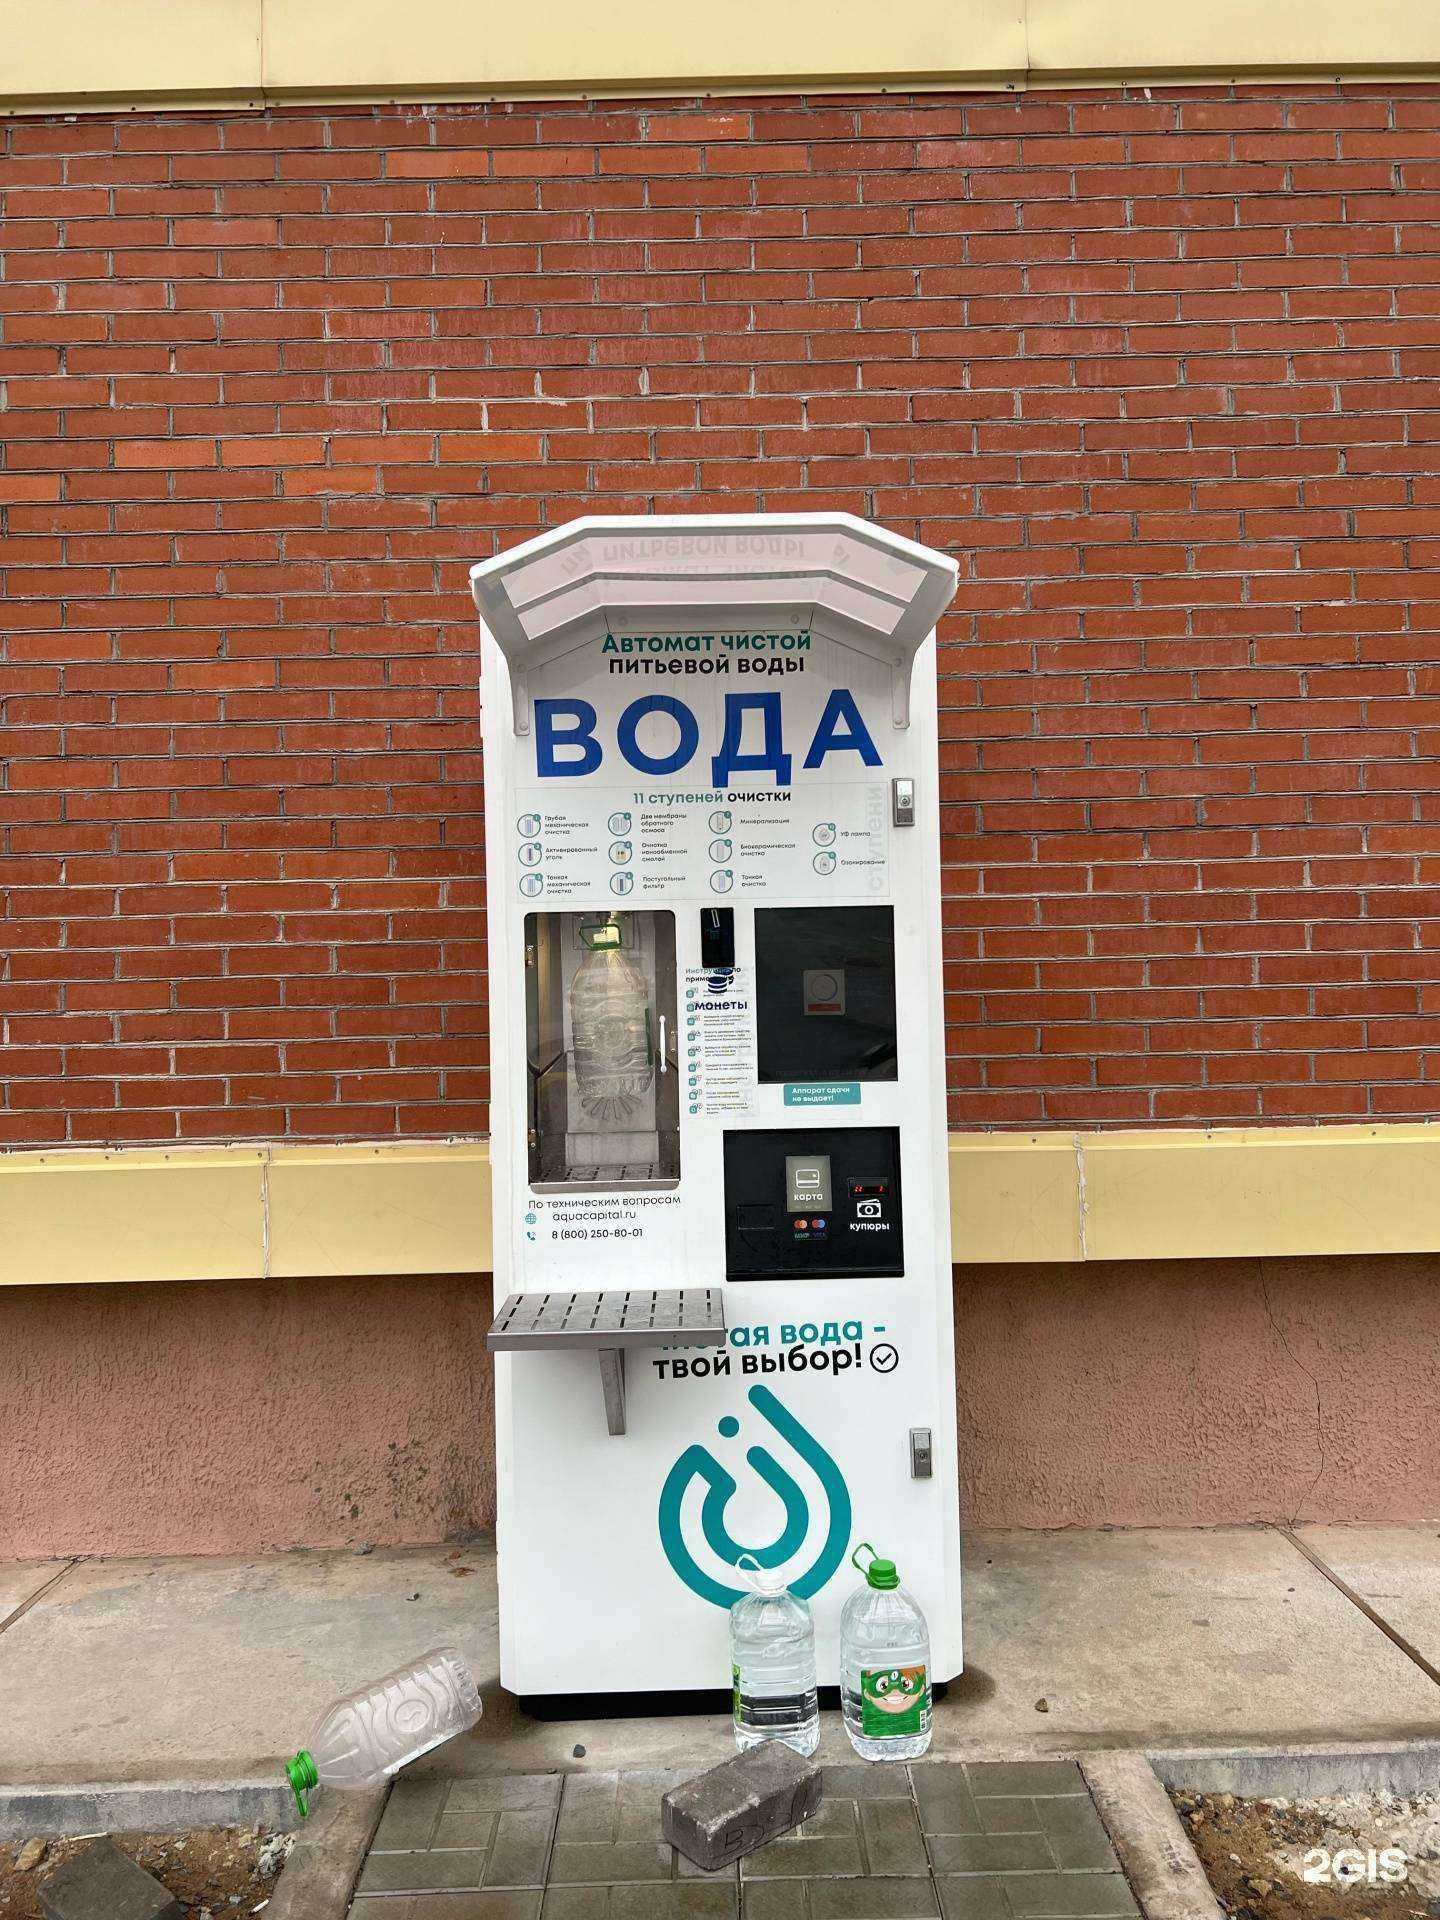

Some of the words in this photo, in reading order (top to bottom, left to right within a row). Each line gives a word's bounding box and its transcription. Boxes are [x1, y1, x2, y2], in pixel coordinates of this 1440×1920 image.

[601, 632, 715, 653] Автомат
[720, 630, 812, 652] чистой
[608, 655, 730, 675] питьевой
[737, 657, 805, 676] воды
[534, 688, 884, 789] ВОДА
[633, 792, 645, 804] 11
[648, 791, 724, 806] ступеней
[727, 791, 792, 803] очистки
[840, 859, 886, 867] Озонирование
[694, 1001, 748, 1011] монеты
[791, 1086, 825, 1096] Аппарат
[826, 1086, 851, 1095] сдачи
[803, 1095, 834, 1103] выдает!
[528, 1200, 543, 1209] По
[546, 1198, 620, 1209] техническим
[622, 1196, 681, 1207] вопросам
[794, 1193, 825, 1203] карта
[552, 1210, 636, 1223] aquacapital.ru
[849, 1222, 891, 1232] купюры
[551, 1230, 558, 1239] 8
[560, 1229, 588, 1240] (800)
[590, 1228, 644, 1239] 250-80-01
[781, 1320, 863, 1346] вода
[653, 1350, 731, 1379] твой
[741, 1342, 862, 1375] выбор!
